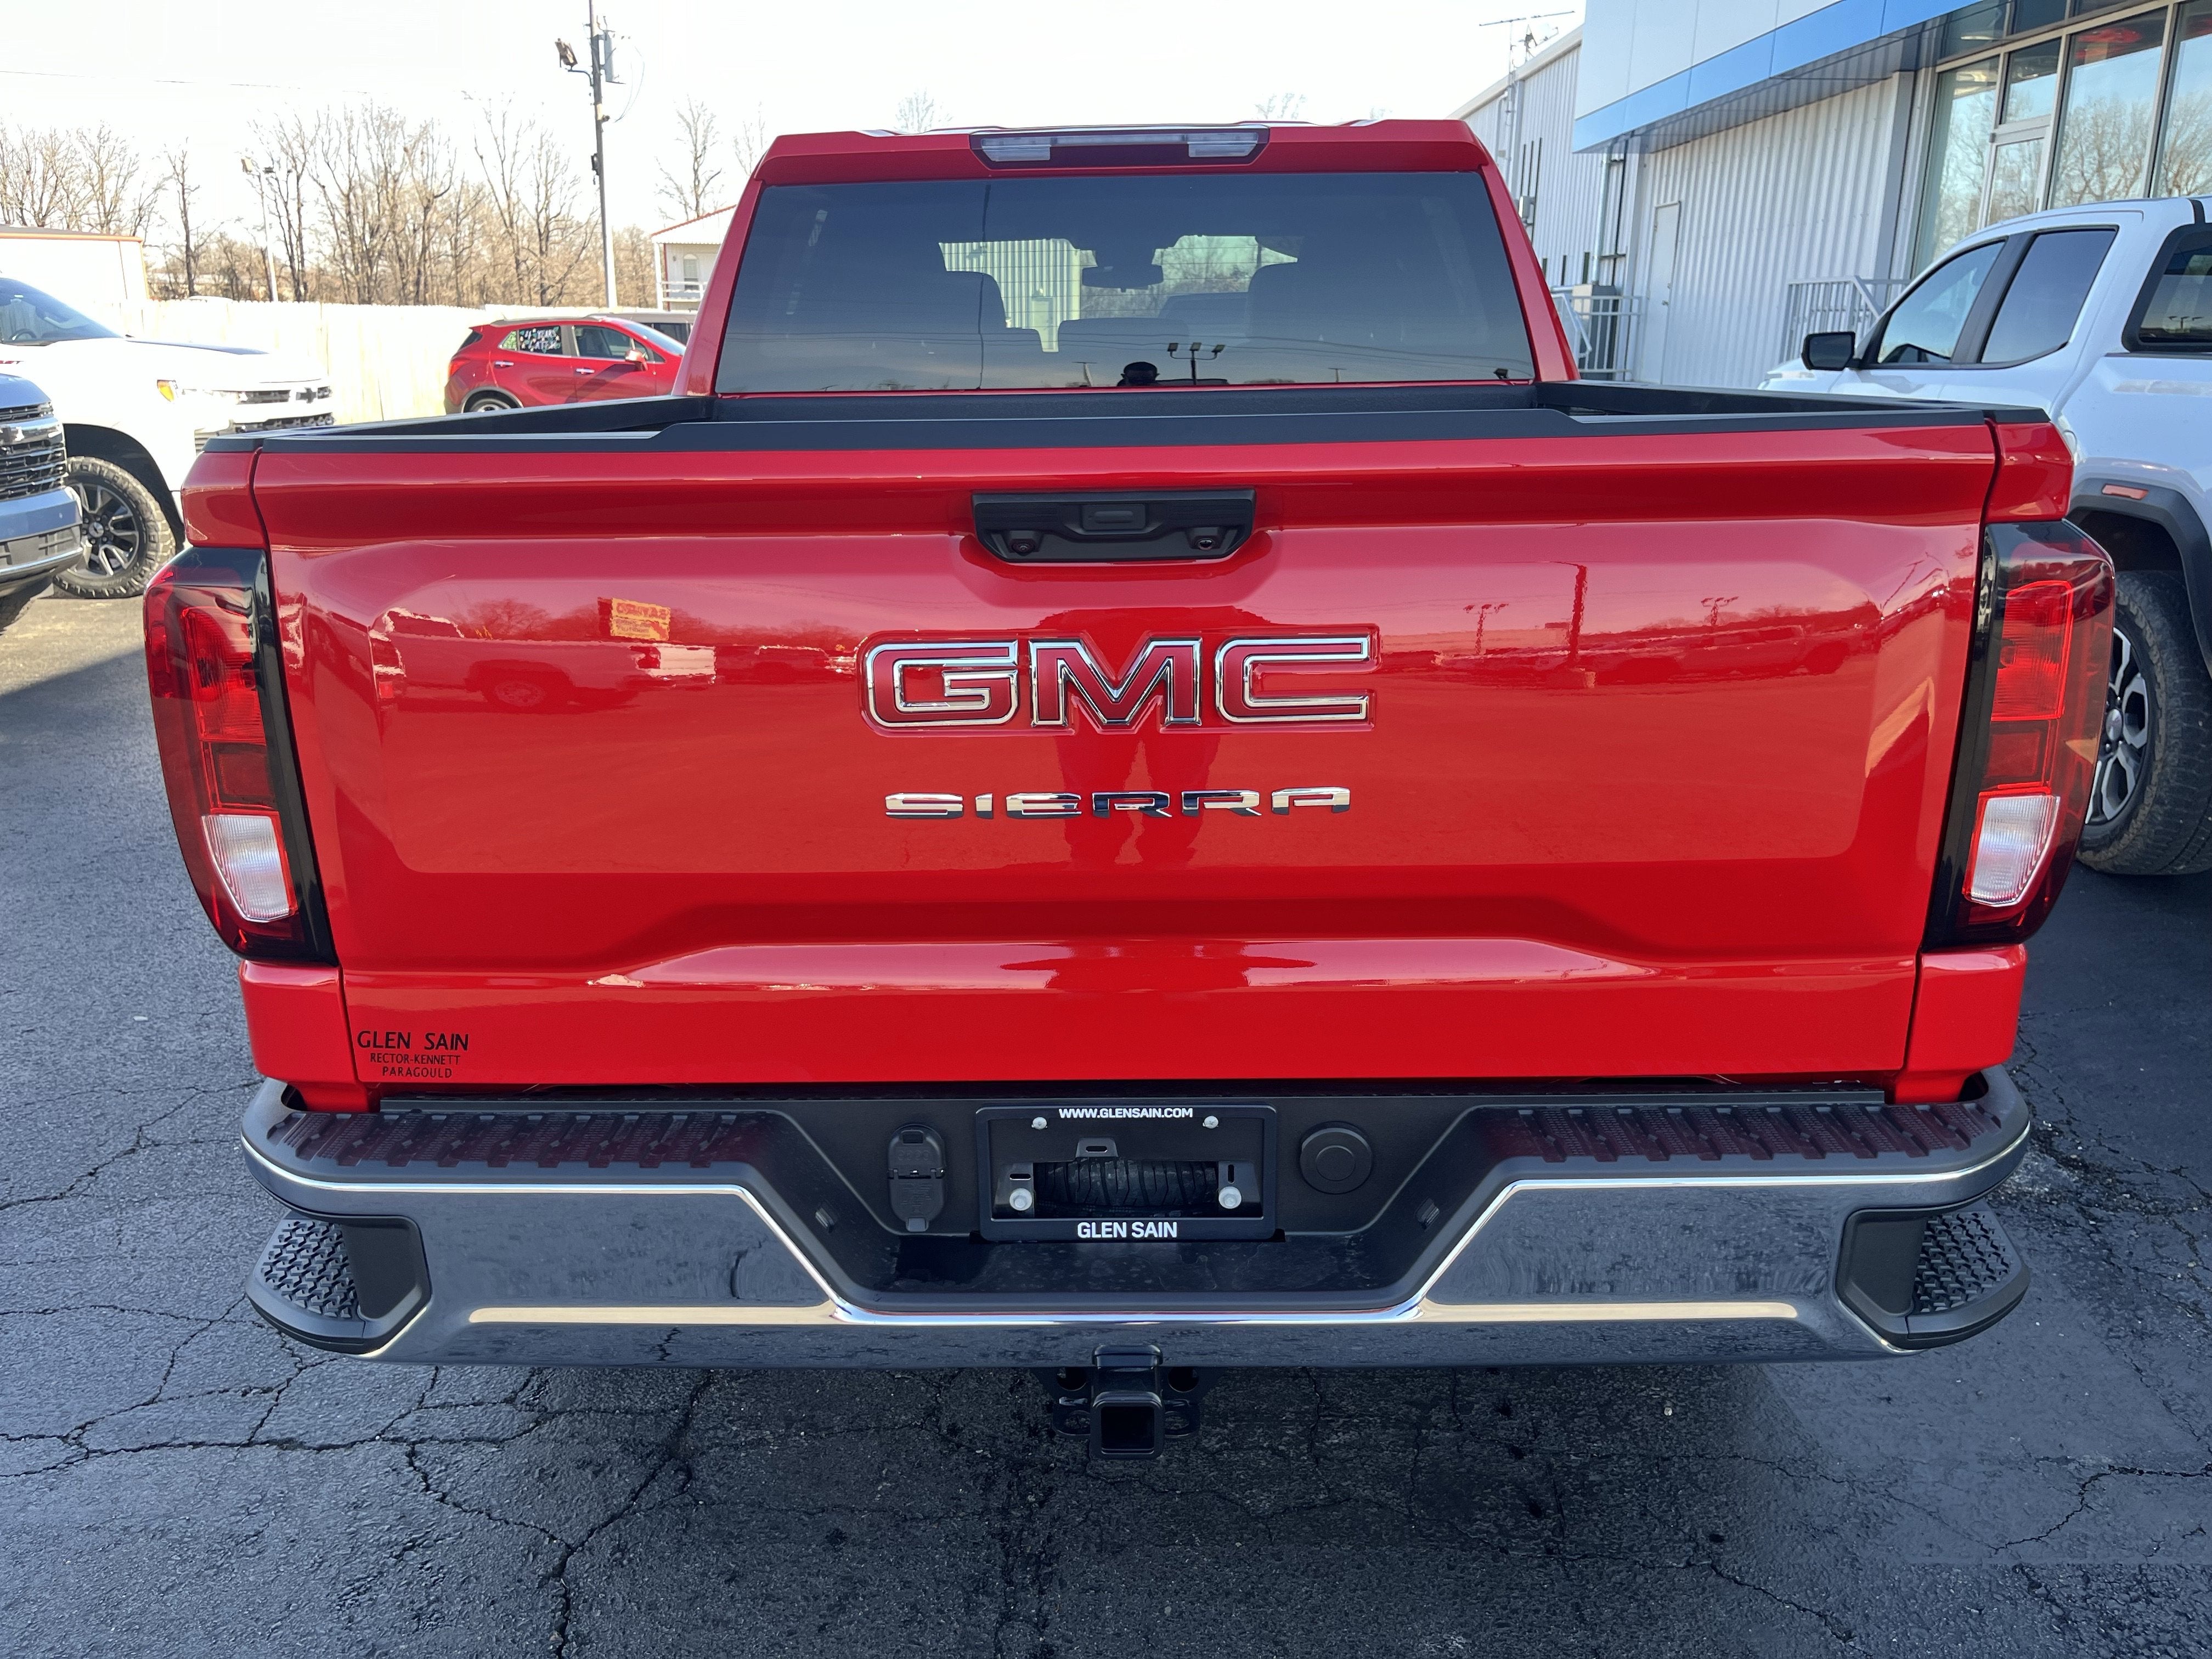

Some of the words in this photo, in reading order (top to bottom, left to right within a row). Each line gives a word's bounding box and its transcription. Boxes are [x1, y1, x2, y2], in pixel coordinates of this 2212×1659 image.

[867, 636, 1371, 729] GMC
[884, 786, 1350, 819] SIERRA
[357, 1030, 411, 1049] GLEN
[424, 1032, 469, 1051] SAIN
[370, 1053, 461, 1065] RECTOR-KENNETT
[382, 1066, 453, 1078] PARAGOULD
[1059, 1108, 1193, 1119] WWW.GLENSAIN.COM
[1077, 1222, 1127, 1238] GLEN
[1131, 1222, 1178, 1238] SAIN
